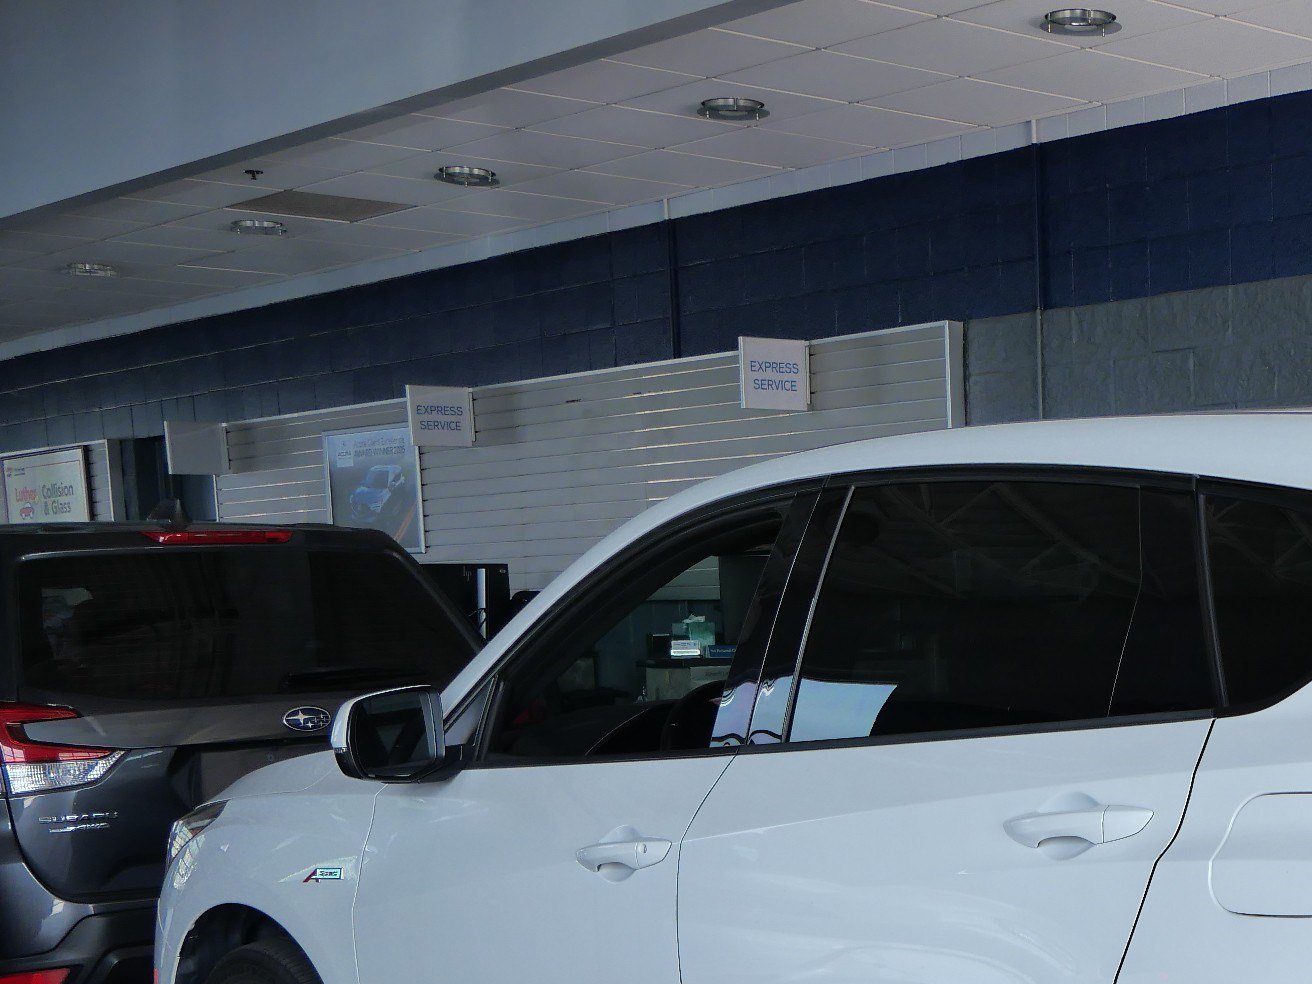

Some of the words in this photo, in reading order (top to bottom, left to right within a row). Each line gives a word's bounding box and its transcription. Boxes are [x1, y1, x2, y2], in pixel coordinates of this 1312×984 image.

[749, 360, 799, 375] EXPRESS
[753, 378, 798, 392] SERVICE
[415, 404, 463, 416] EXPRESS
[419, 420, 462, 431] SERVICE
[41, 481, 75, 500] Collision
[51, 501, 72, 515] Glass
[38, 811, 119, 824] SUBARU
